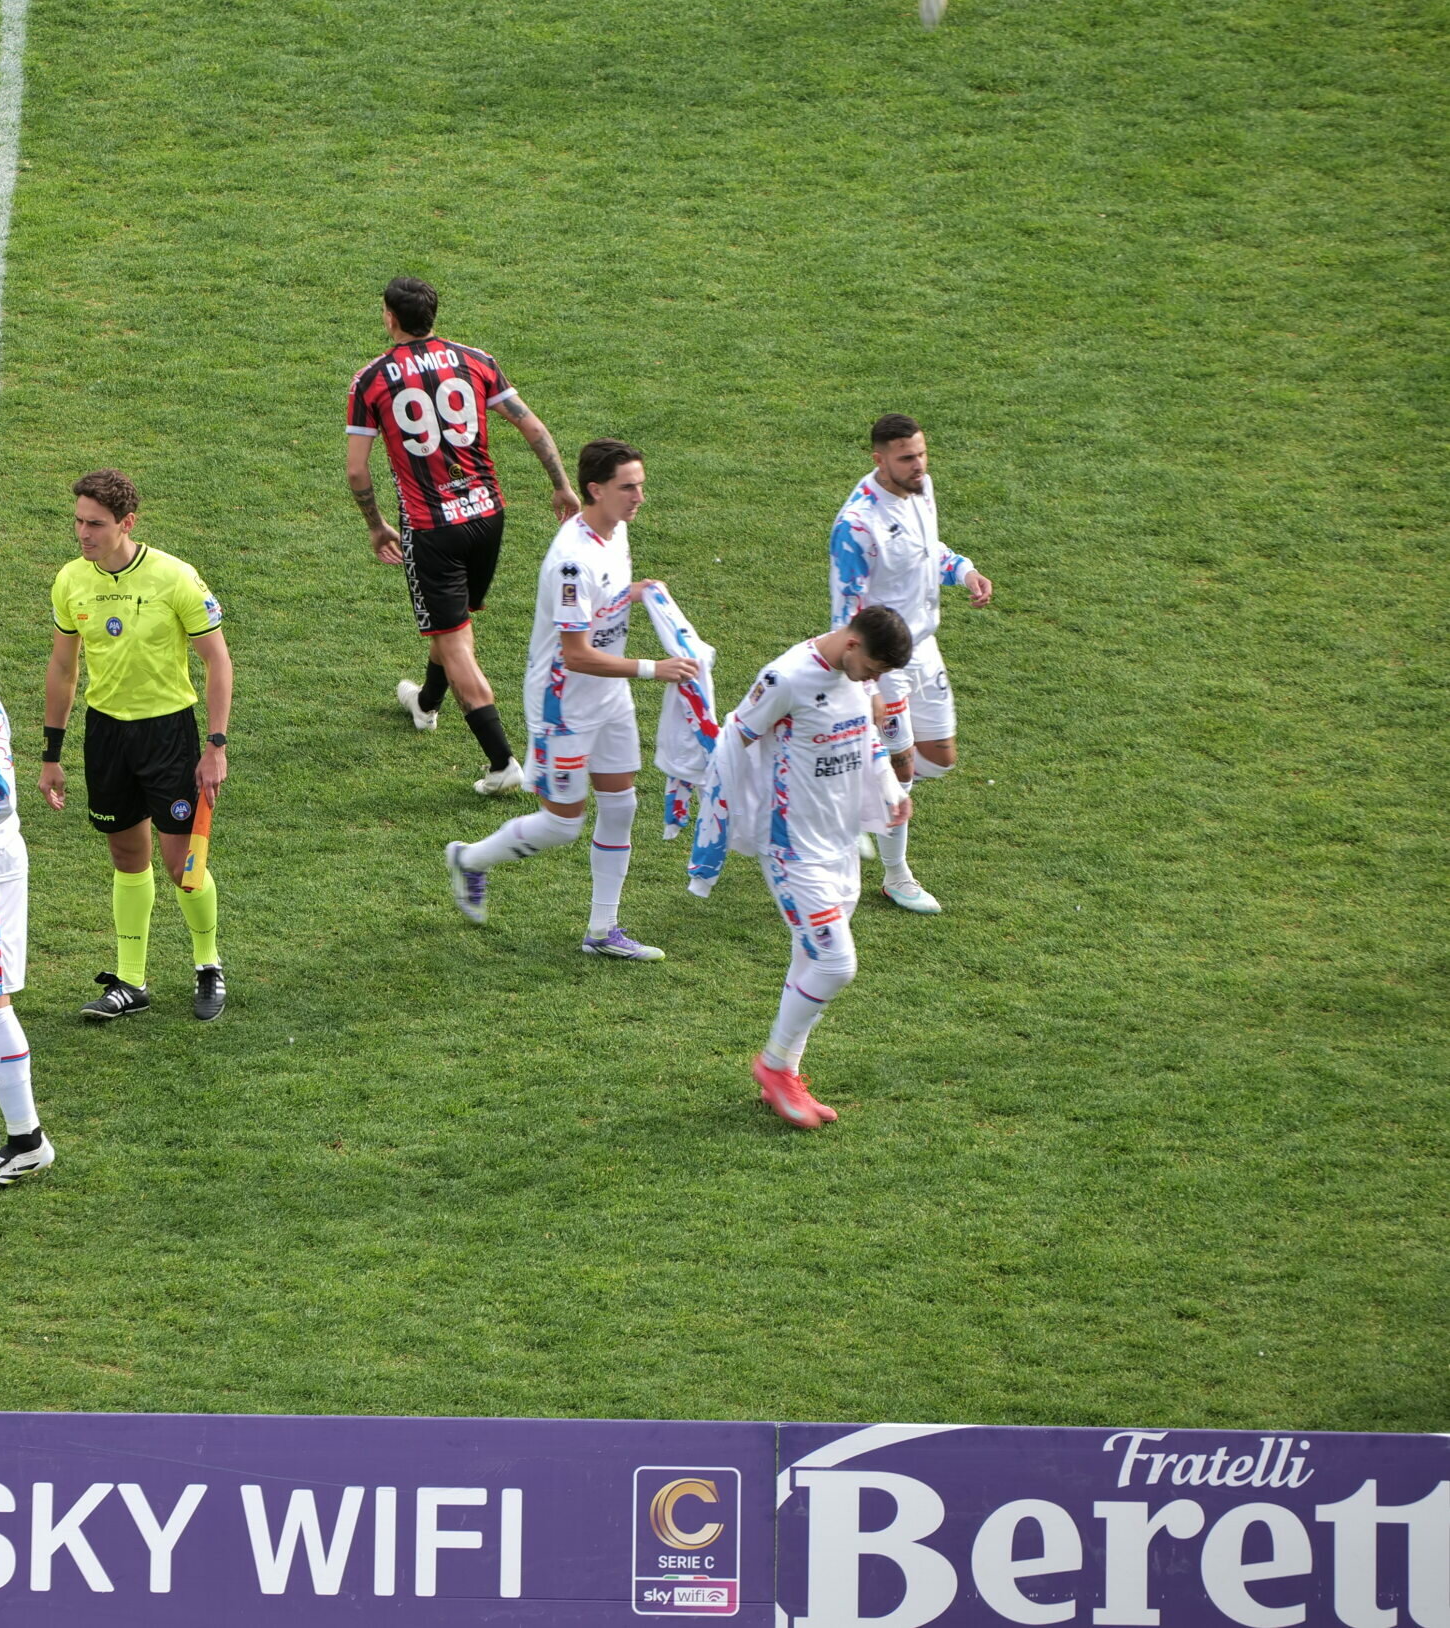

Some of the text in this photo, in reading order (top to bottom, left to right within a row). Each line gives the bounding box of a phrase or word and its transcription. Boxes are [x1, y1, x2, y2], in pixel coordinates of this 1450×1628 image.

[386, 349, 460, 382] D'AMICO
[392, 377, 479, 457] 99
[460, 498, 495, 518] CARLO
[1103, 1432, 1315, 1489] Fratelli
[240, 1484, 523, 1598] WIFI
[658, 1555, 715, 1569] SERIE C
[643, 1588, 706, 1606] sky wifi
